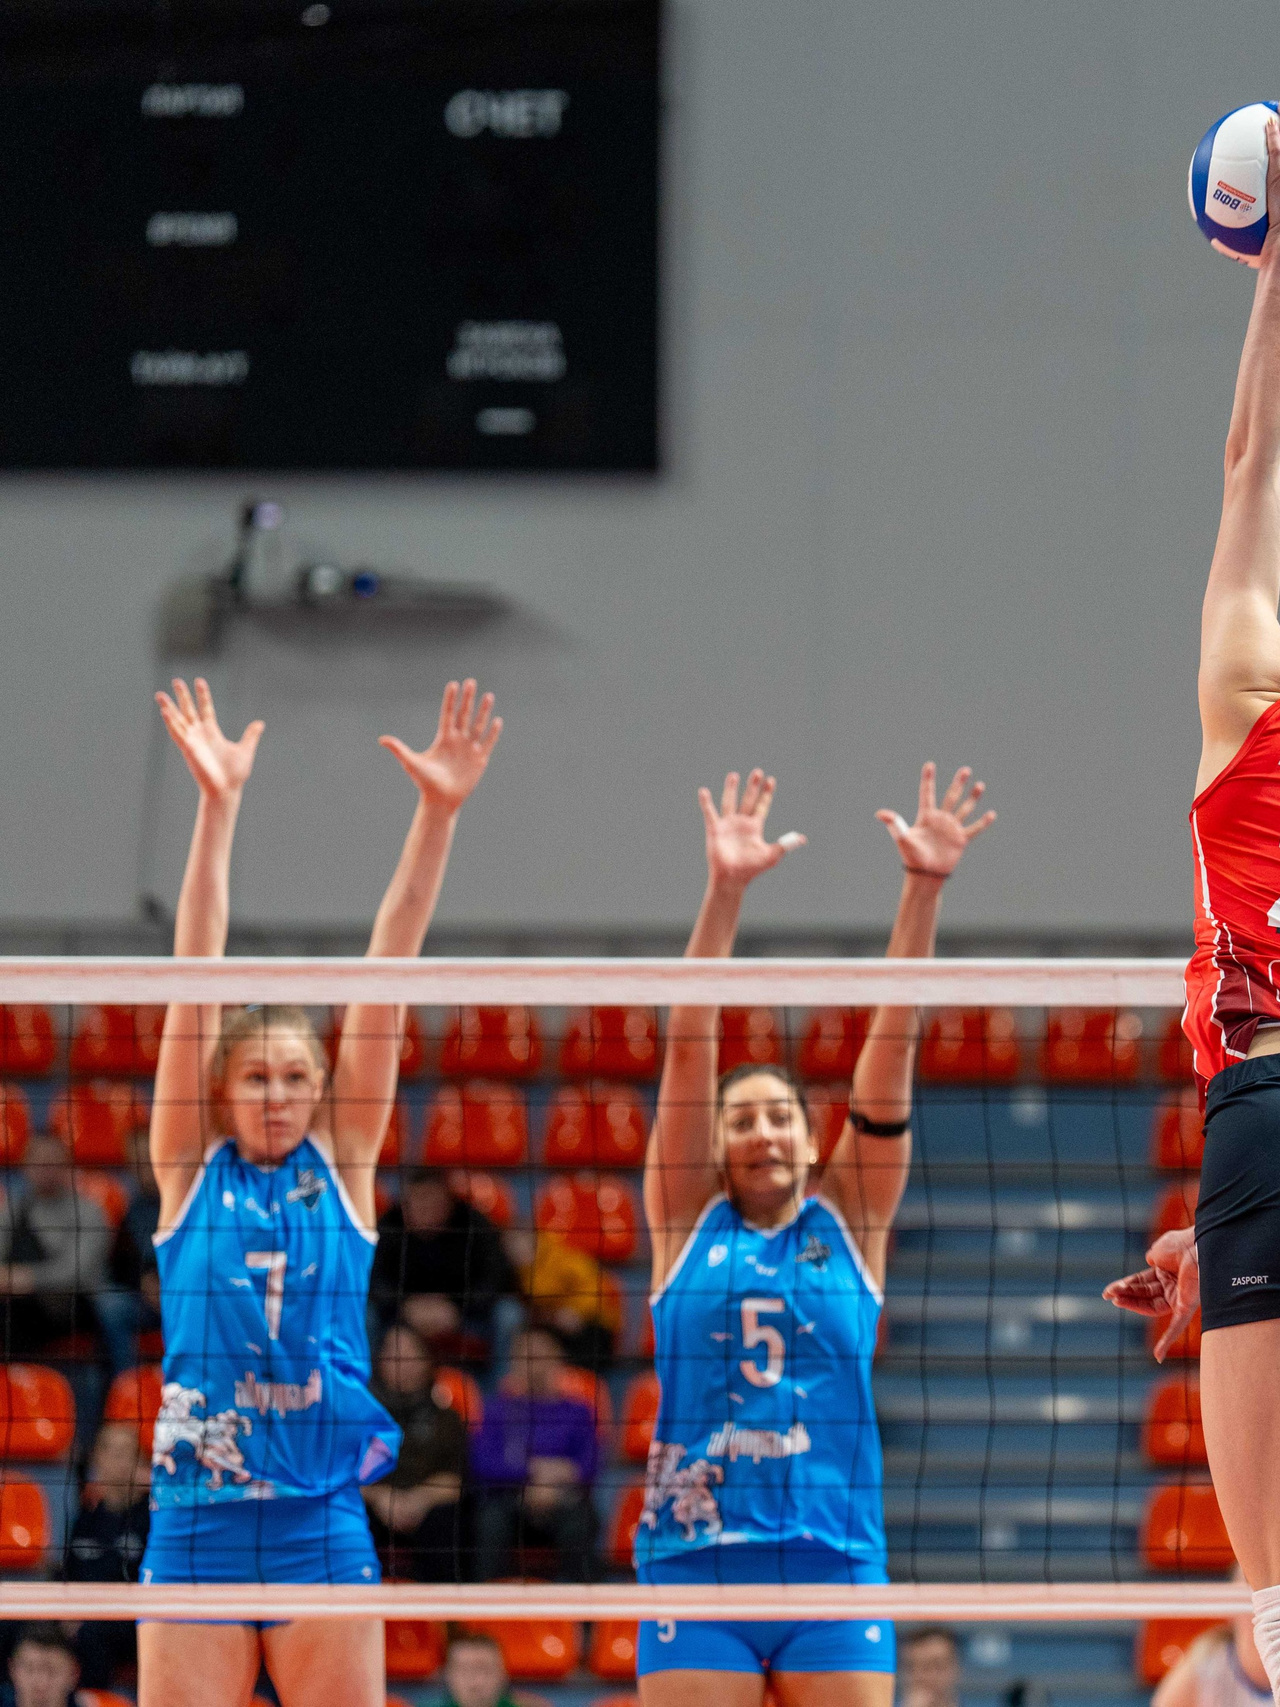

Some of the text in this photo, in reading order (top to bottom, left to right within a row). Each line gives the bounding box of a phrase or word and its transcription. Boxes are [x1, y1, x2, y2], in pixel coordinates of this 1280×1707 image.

[245, 1251, 287, 1340] 7
[1231, 1275, 1269, 1287] ZASPORT
[739, 1298, 787, 1388] 5
